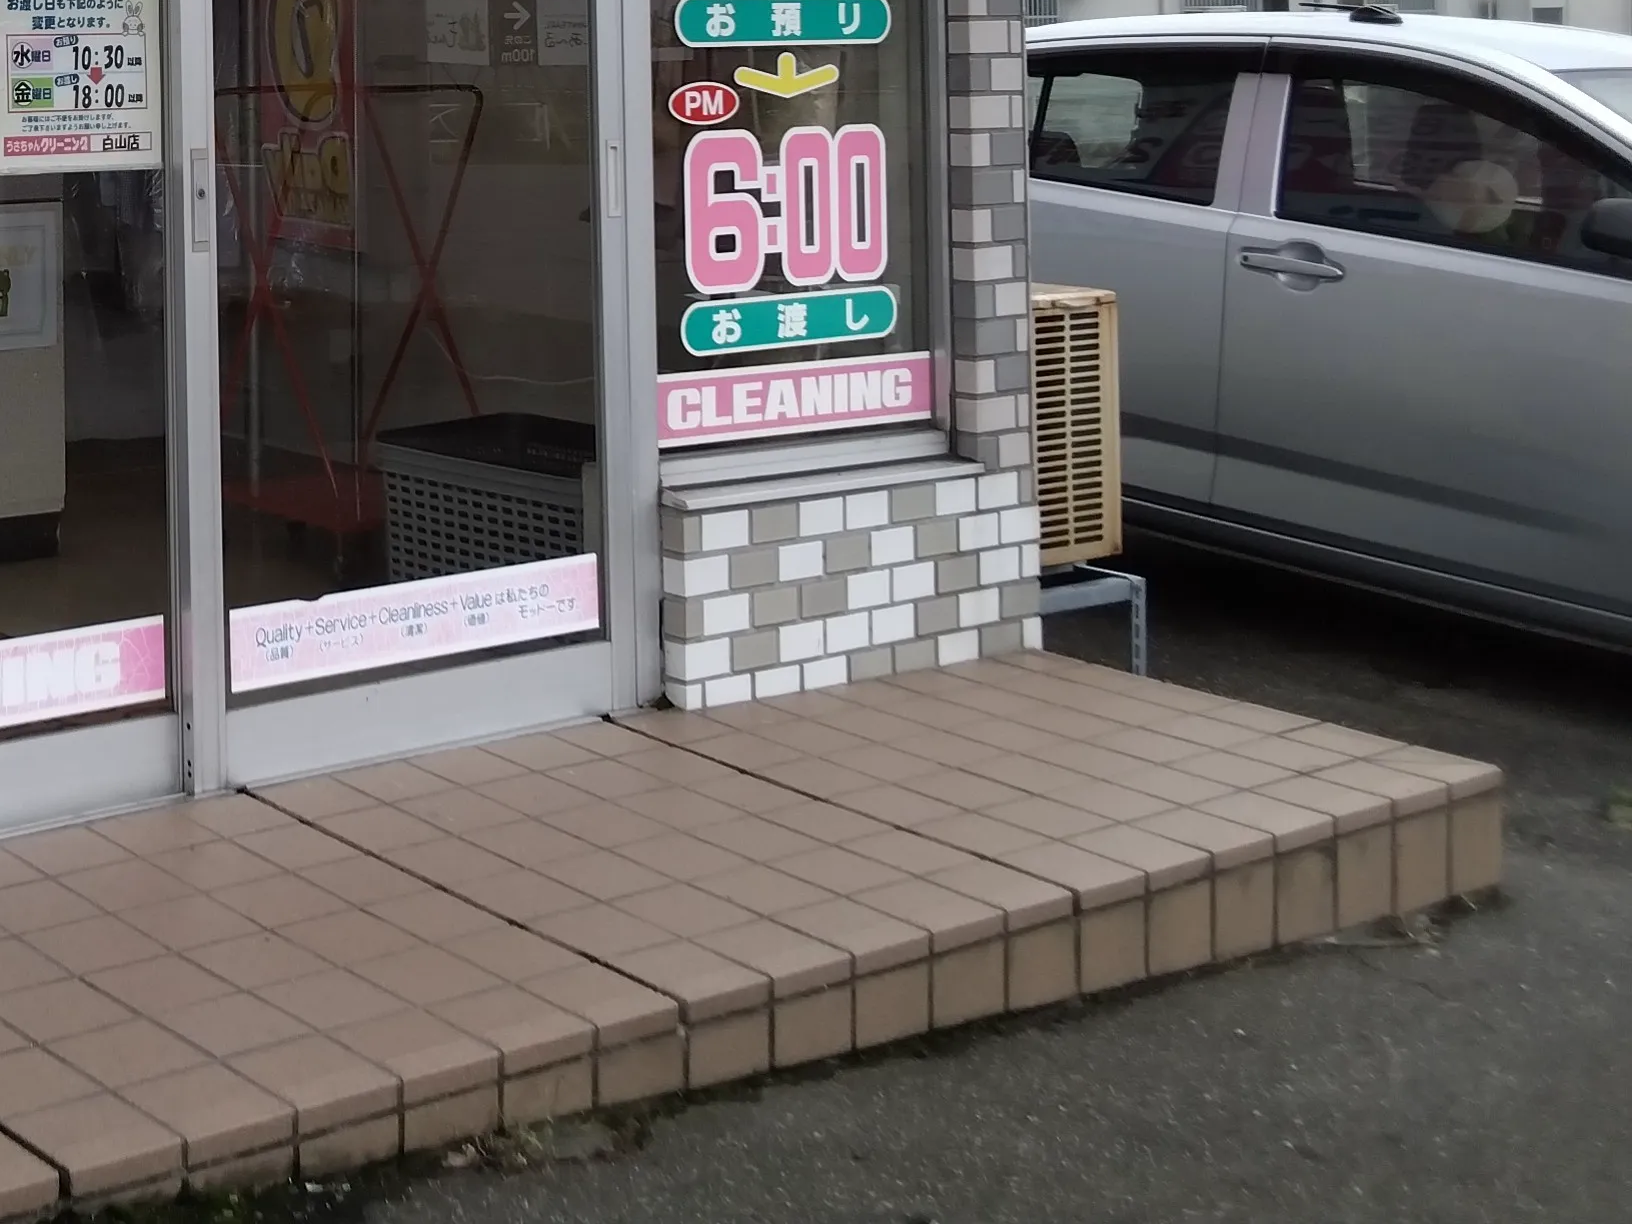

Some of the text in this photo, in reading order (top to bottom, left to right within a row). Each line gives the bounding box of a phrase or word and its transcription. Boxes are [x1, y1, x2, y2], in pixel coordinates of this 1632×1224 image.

[32, 16, 111, 31] 変更となります。
[13, 44, 52, 67] 水曜日
[14, 81, 52, 104] 金曜日
[684, 89, 724, 116] PM
[6, 134, 140, 153] うさちゃんクリーニング 白山店
[683, 123, 888, 295] 6:00
[712, 298, 869, 345] お渡し
[667, 367, 913, 431] CLEANING
[518, 596, 576, 619] モットーです
[255, 624, 303, 648] Quality
[315, 611, 368, 636] Service
[378, 598, 449, 625] Cleanliness
